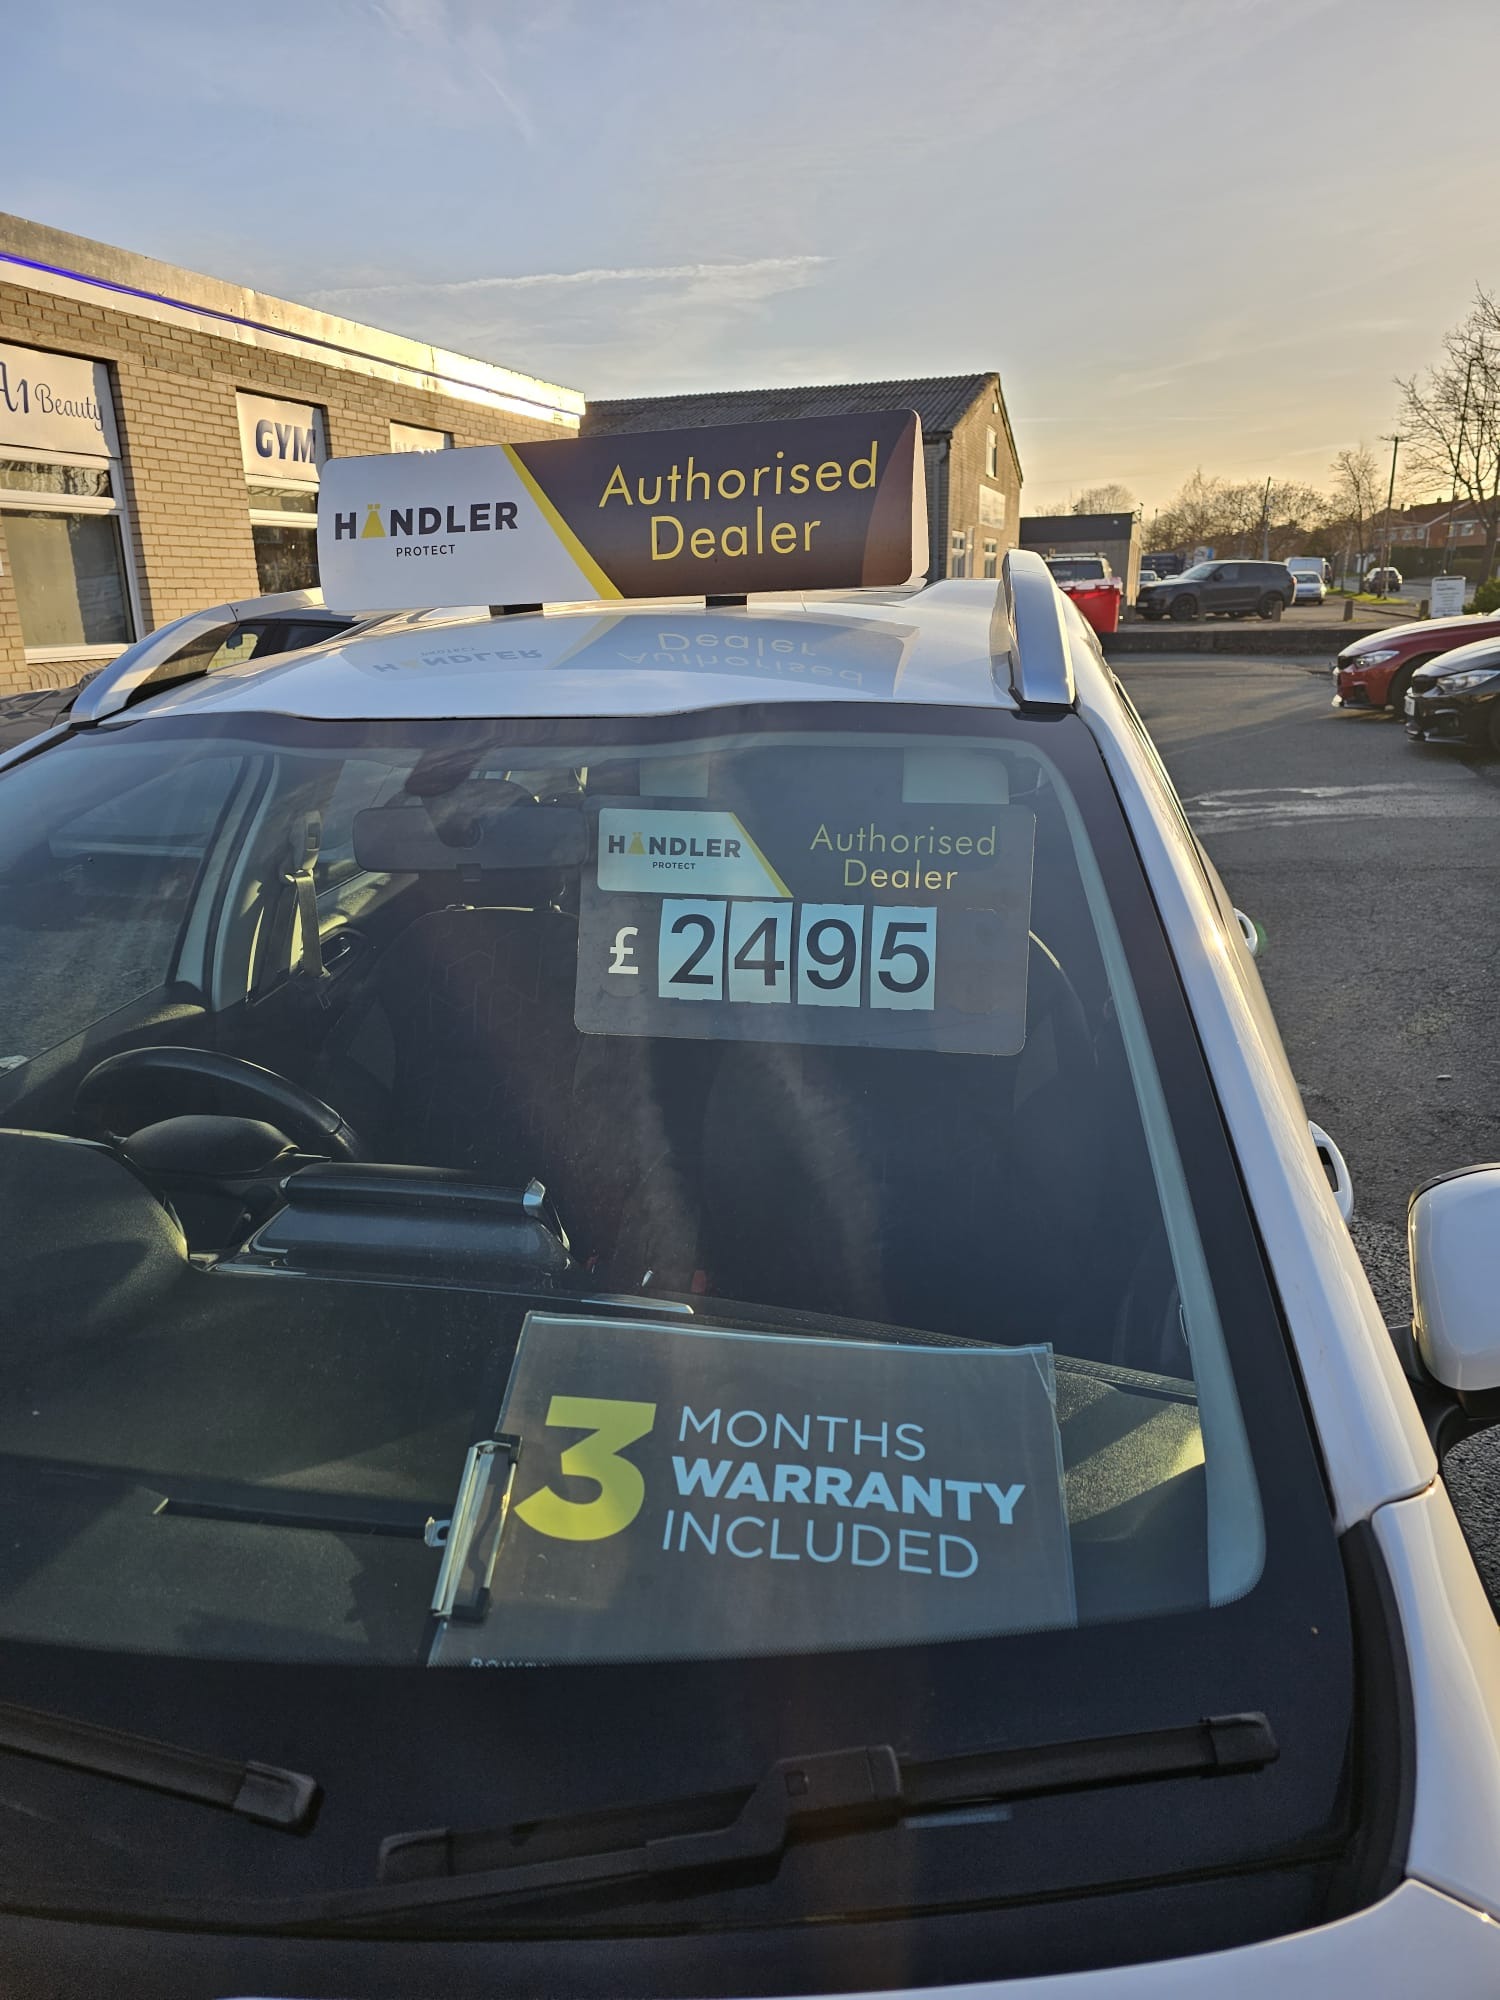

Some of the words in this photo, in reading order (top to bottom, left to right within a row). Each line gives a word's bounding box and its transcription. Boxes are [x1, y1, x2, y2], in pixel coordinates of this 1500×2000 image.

[34, 383, 104, 431] Beauty
[255, 419, 317, 464] GYM
[598, 440, 878, 508] Authorised
[335, 502, 518, 541] HÄNDLER
[651, 506, 822, 560] Dealer
[396, 544, 456, 558] PROTECT
[809, 823, 997, 856] Authorised
[652, 861, 697, 870] PROTECT
[844, 858, 959, 890] Dealer
[679, 1405, 926, 1462] MONTHS
[513, 1395, 657, 1541] 3
[672, 1455, 1026, 1526] WARRANTY
[662, 1509, 979, 1579] INCLUDED
